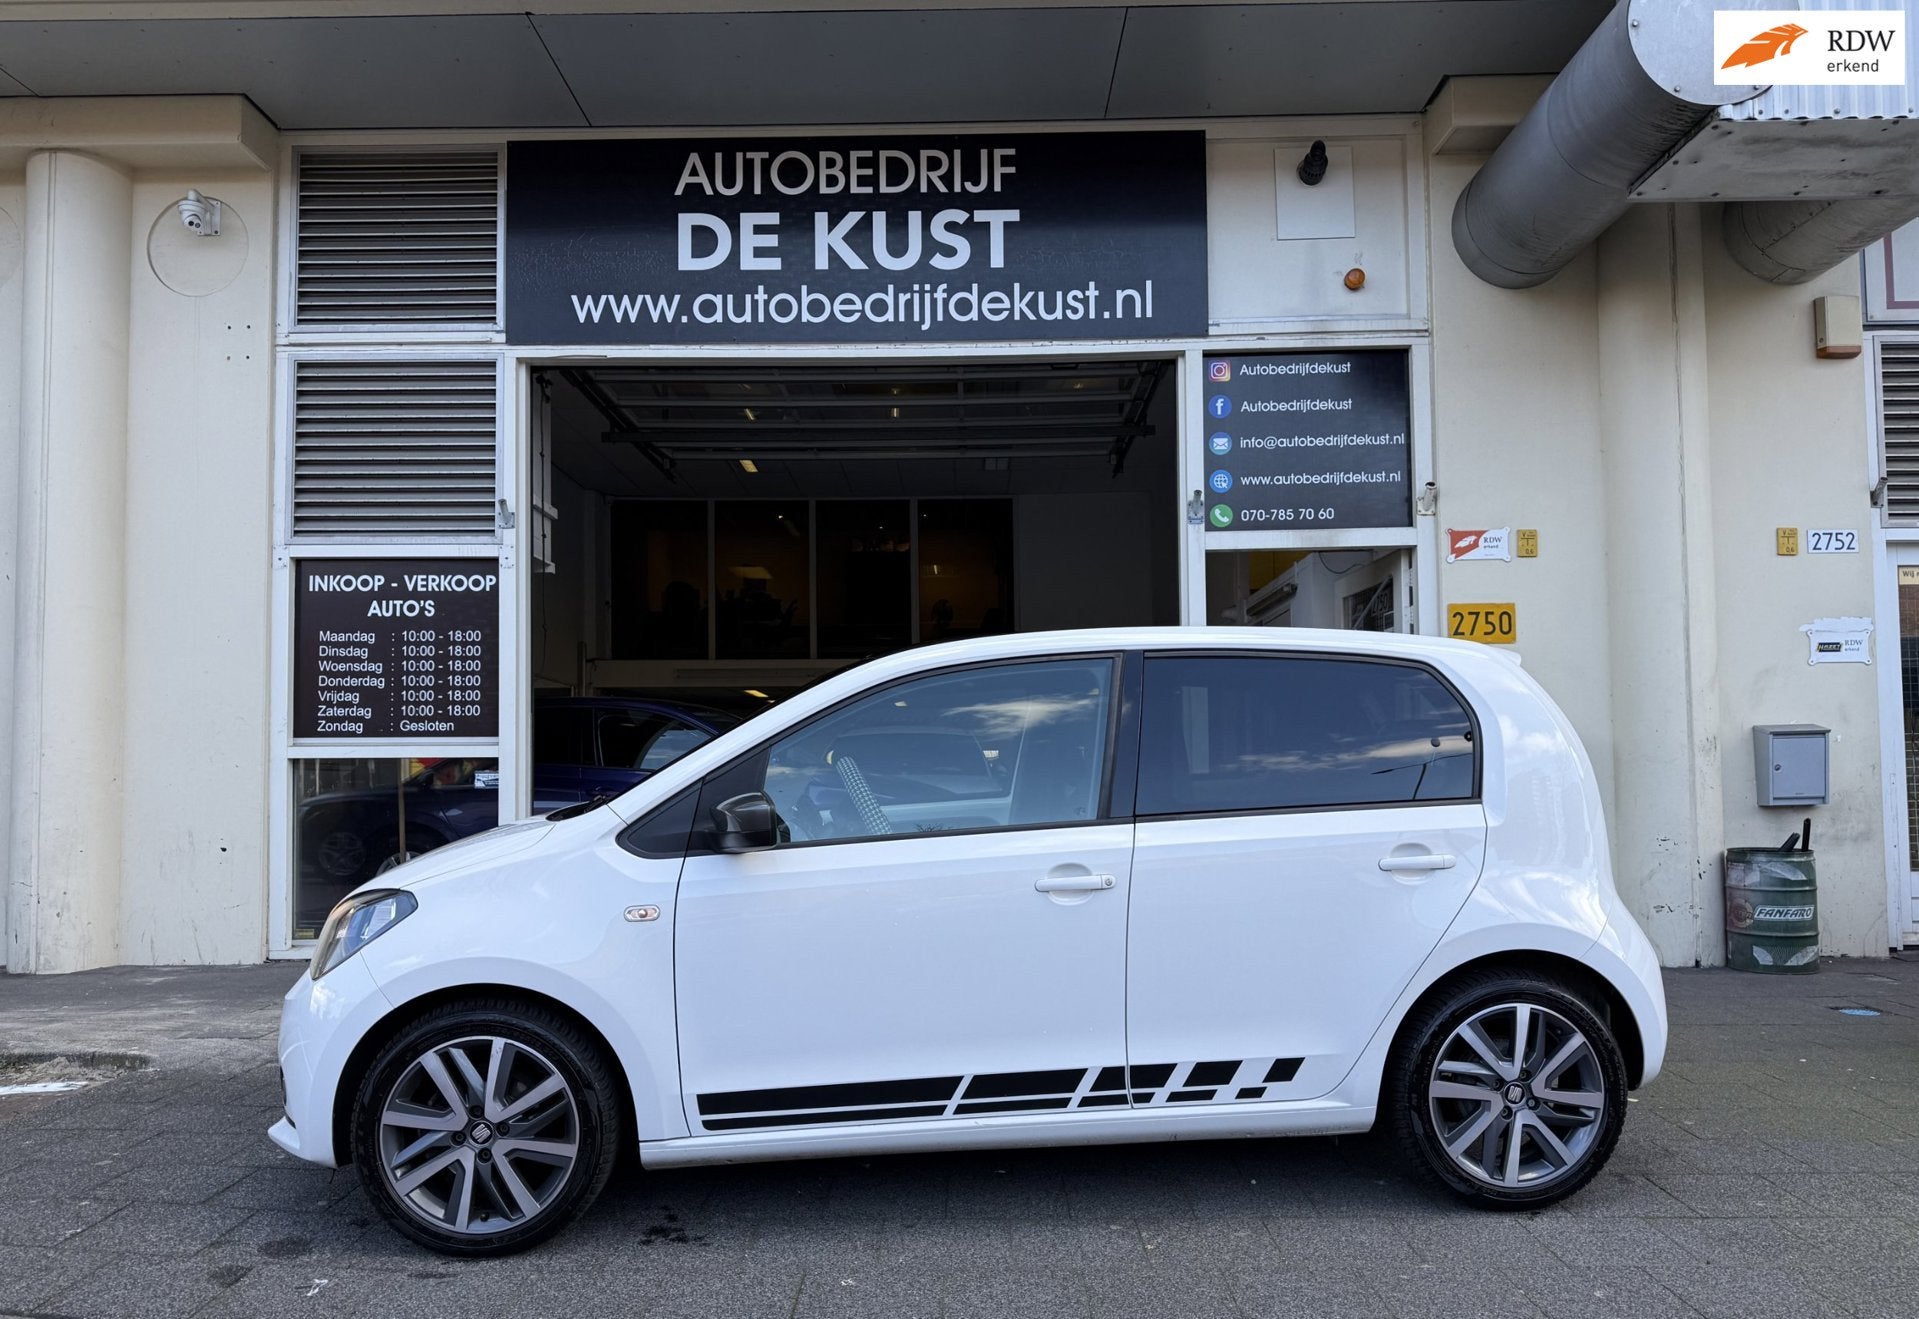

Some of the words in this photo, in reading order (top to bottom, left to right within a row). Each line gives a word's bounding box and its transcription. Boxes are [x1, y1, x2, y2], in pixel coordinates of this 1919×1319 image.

[674, 149, 1015, 195] AUTOBEDRIJF
[678, 213, 781, 270] DE
[815, 209, 1019, 270] KUST
[571, 280, 1152, 330] www.autobedrijfdekust.nl
[1240, 362, 1350, 376] Autobedrijfdekust
[1241, 399, 1352, 412] Autobedrijfdekust
[1241, 433, 1404, 449] info@autobedrijfdekust.nl
[1241, 471, 1400, 485] www.autobedrijfdekust.nl
[1241, 509, 1294, 521] 070-785
[1299, 509, 1314, 519] 70
[1318, 508, 1334, 519] 60
[1483, 536, 1503, 544] RDW
[1812, 532, 1855, 550] 2752
[309, 575, 384, 591] INKOOP
[404, 575, 496, 591] VERKOOP
[368, 600, 435, 617] AUTO'S
[1453, 611, 1512, 635] 2750
[320, 631, 375, 644] Maandag
[402, 631, 435, 641] 10:00
[448, 631, 481, 641] 18:00
[320, 646, 368, 659] Dinsdag
[402, 646, 435, 656] 10:00
[448, 646, 481, 656] 18:00
[319, 661, 382, 674] Woensdag
[402, 660, 434, 671] 10:00
[448, 660, 480, 671] 18:00
[319, 676, 384, 688] Donderdag
[402, 675, 434, 686] 10:00
[448, 675, 480, 686] 18:00
[318, 691, 359, 704] Vrijdag
[402, 690, 434, 701] 10:00
[448, 690, 480, 701] 18:00
[318, 705, 371, 719] Zaterdag
[401, 705, 434, 716] 10:00
[448, 705, 480, 716] 18:00
[317, 721, 363, 733] Zondag
[400, 720, 454, 731] Gesloten
[1756, 908, 1812, 918] FANFARO
